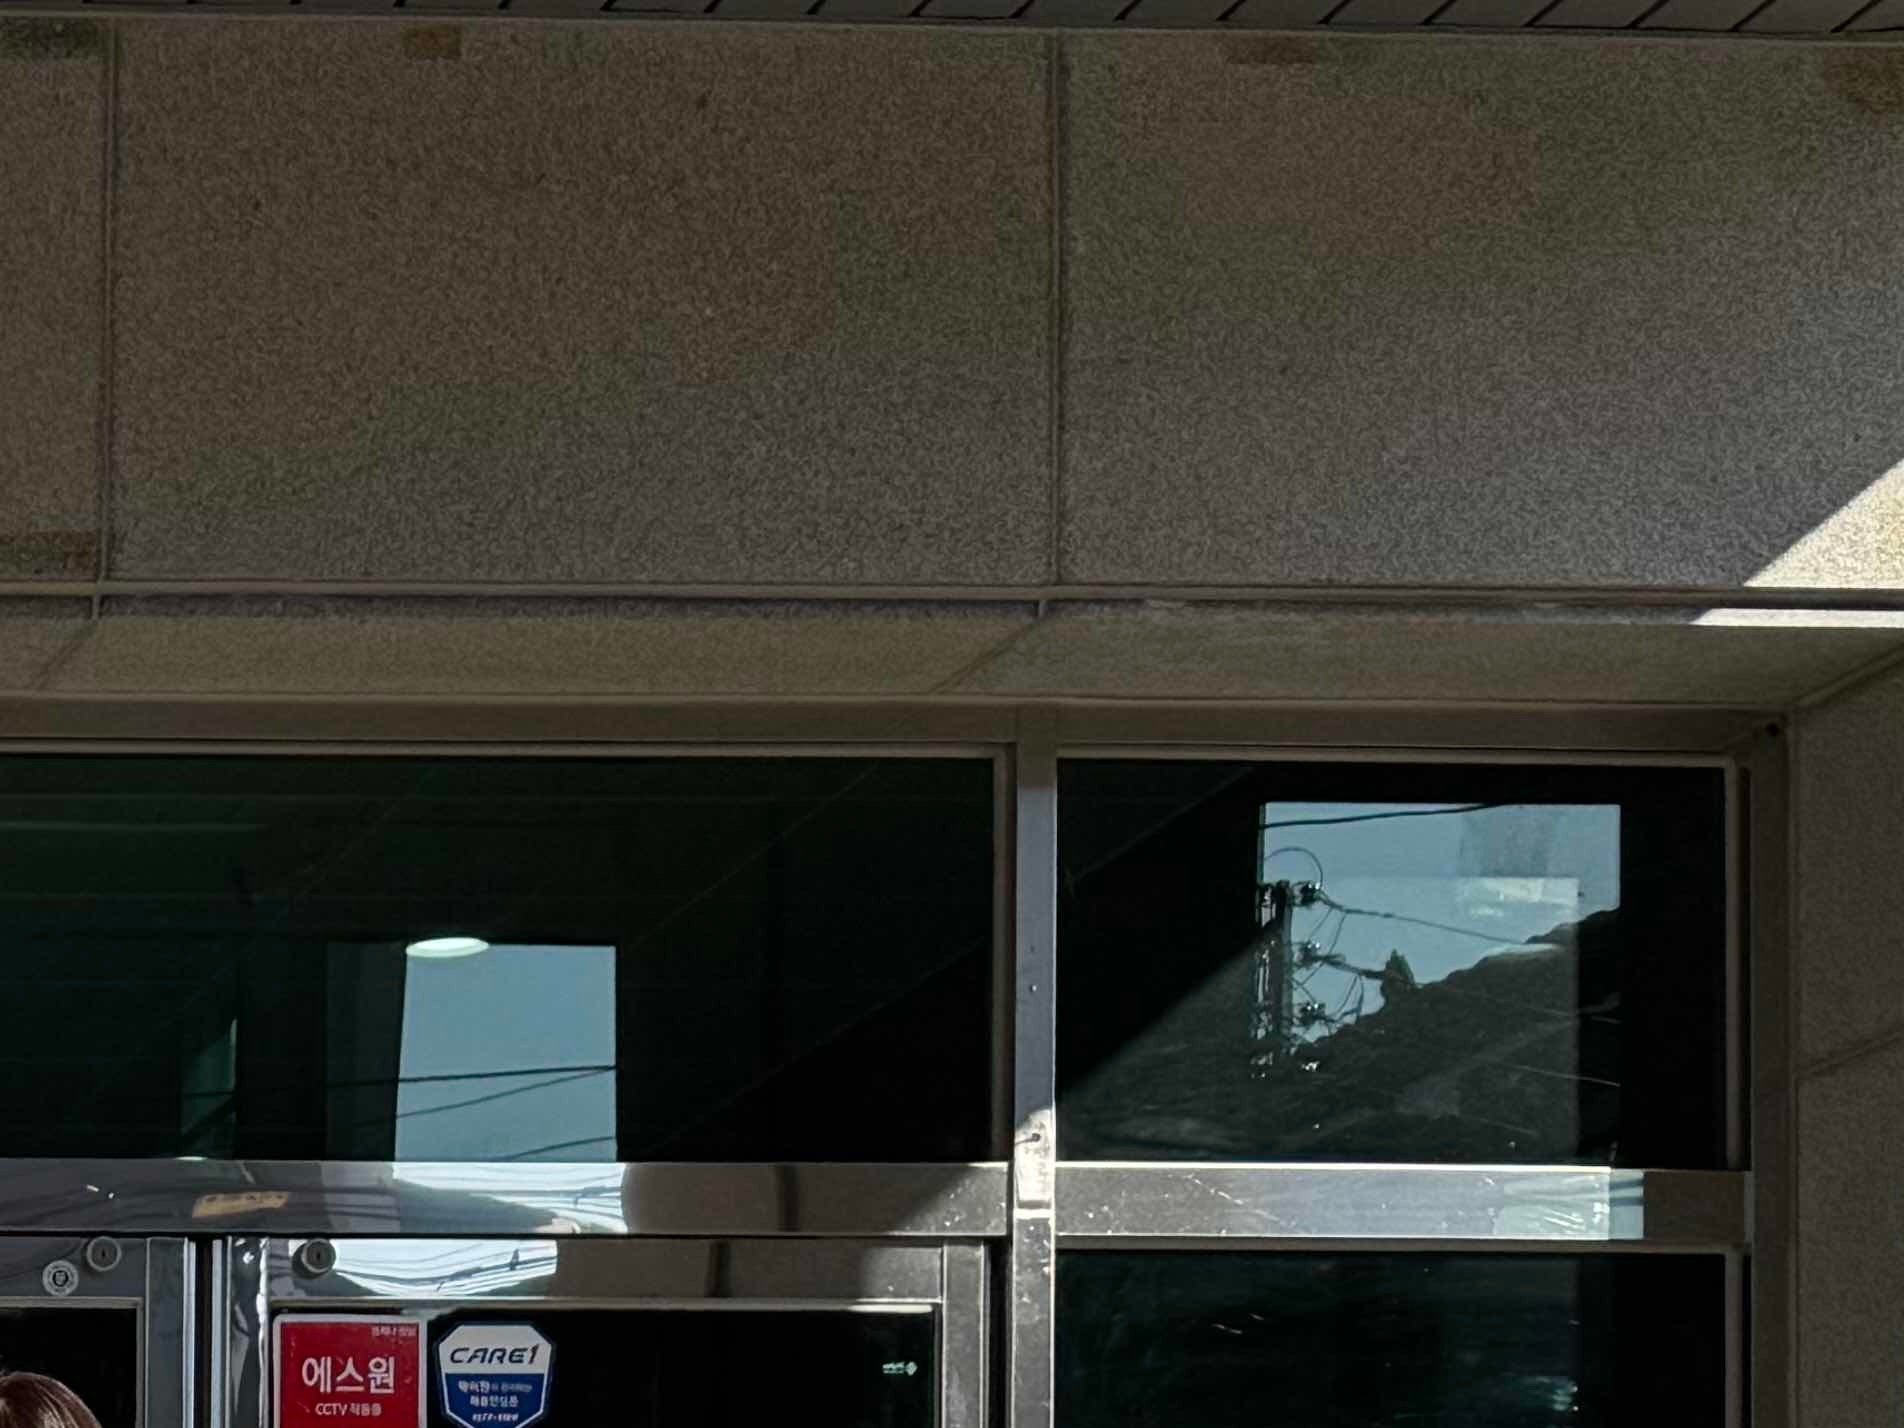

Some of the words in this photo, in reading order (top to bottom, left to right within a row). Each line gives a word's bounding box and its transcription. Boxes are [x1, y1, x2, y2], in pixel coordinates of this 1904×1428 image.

[450, 1345, 539, 1364] CARE1
[302, 1356, 395, 1394] 에스원
[315, 1402, 347, 1415] CCTV
